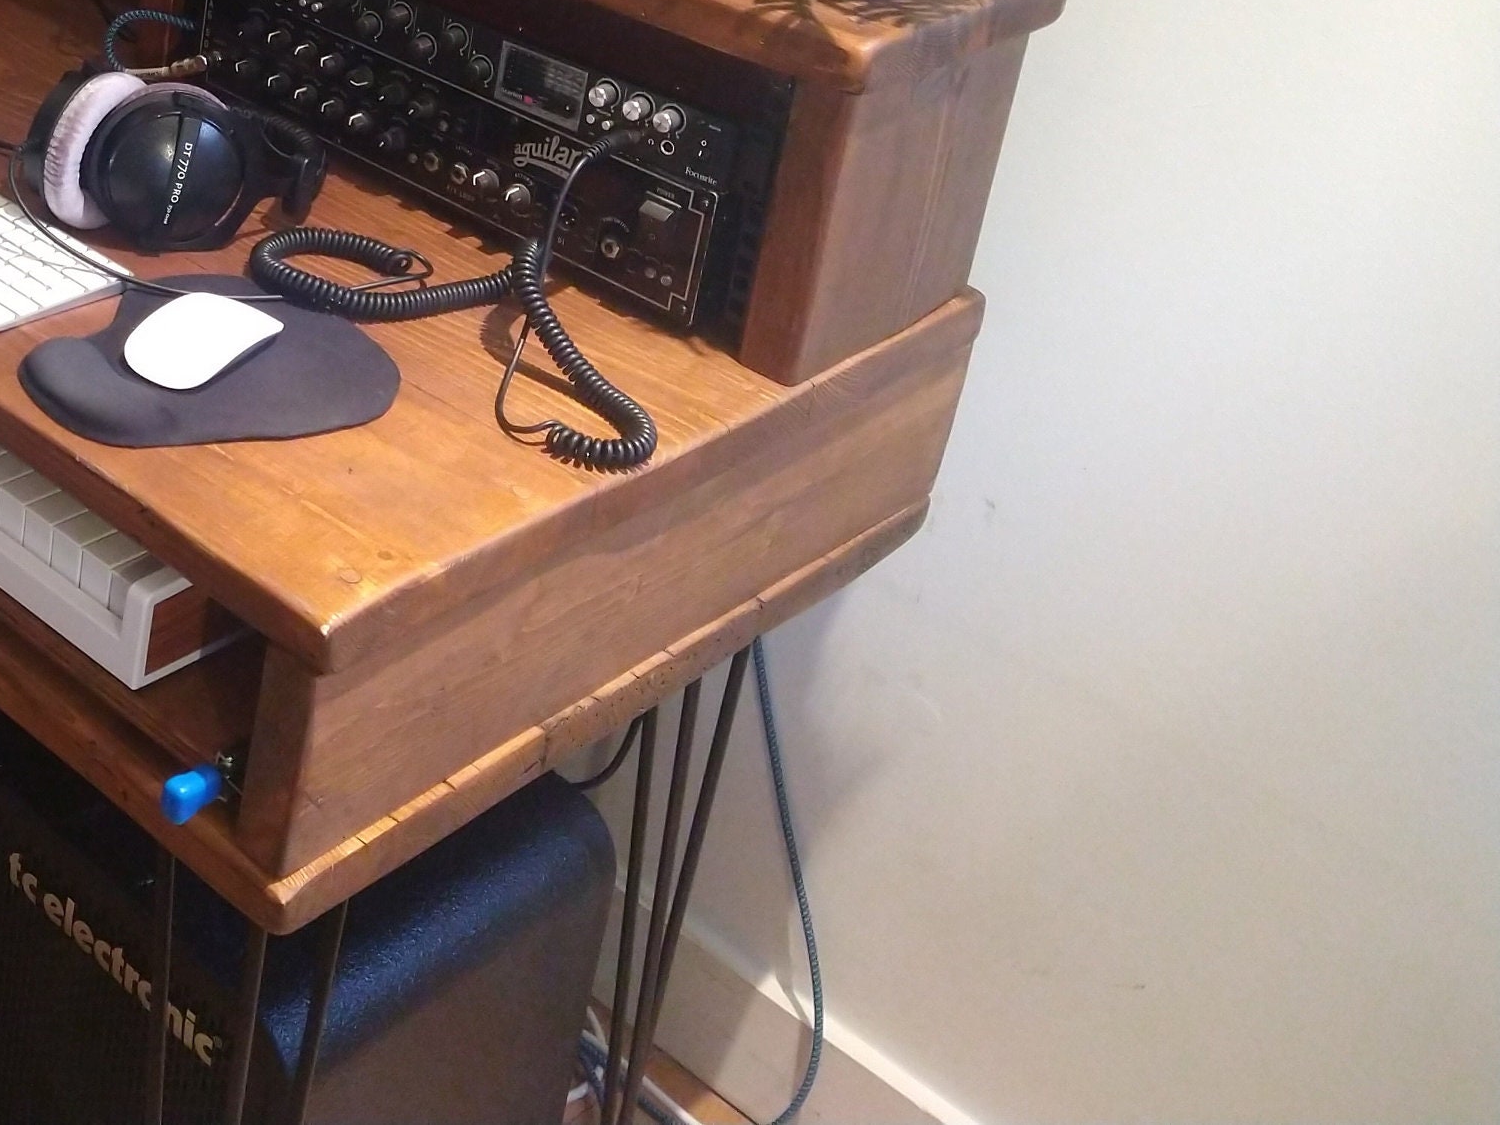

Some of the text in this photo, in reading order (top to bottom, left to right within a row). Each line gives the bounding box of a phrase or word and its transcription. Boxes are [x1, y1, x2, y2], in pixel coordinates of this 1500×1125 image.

[183, 142, 193, 158] DT
[513, 135, 582, 170] aguilar
[177, 158, 190, 180] 770
[170, 182, 183, 203] PRO
[8, 852, 39, 905] tc
